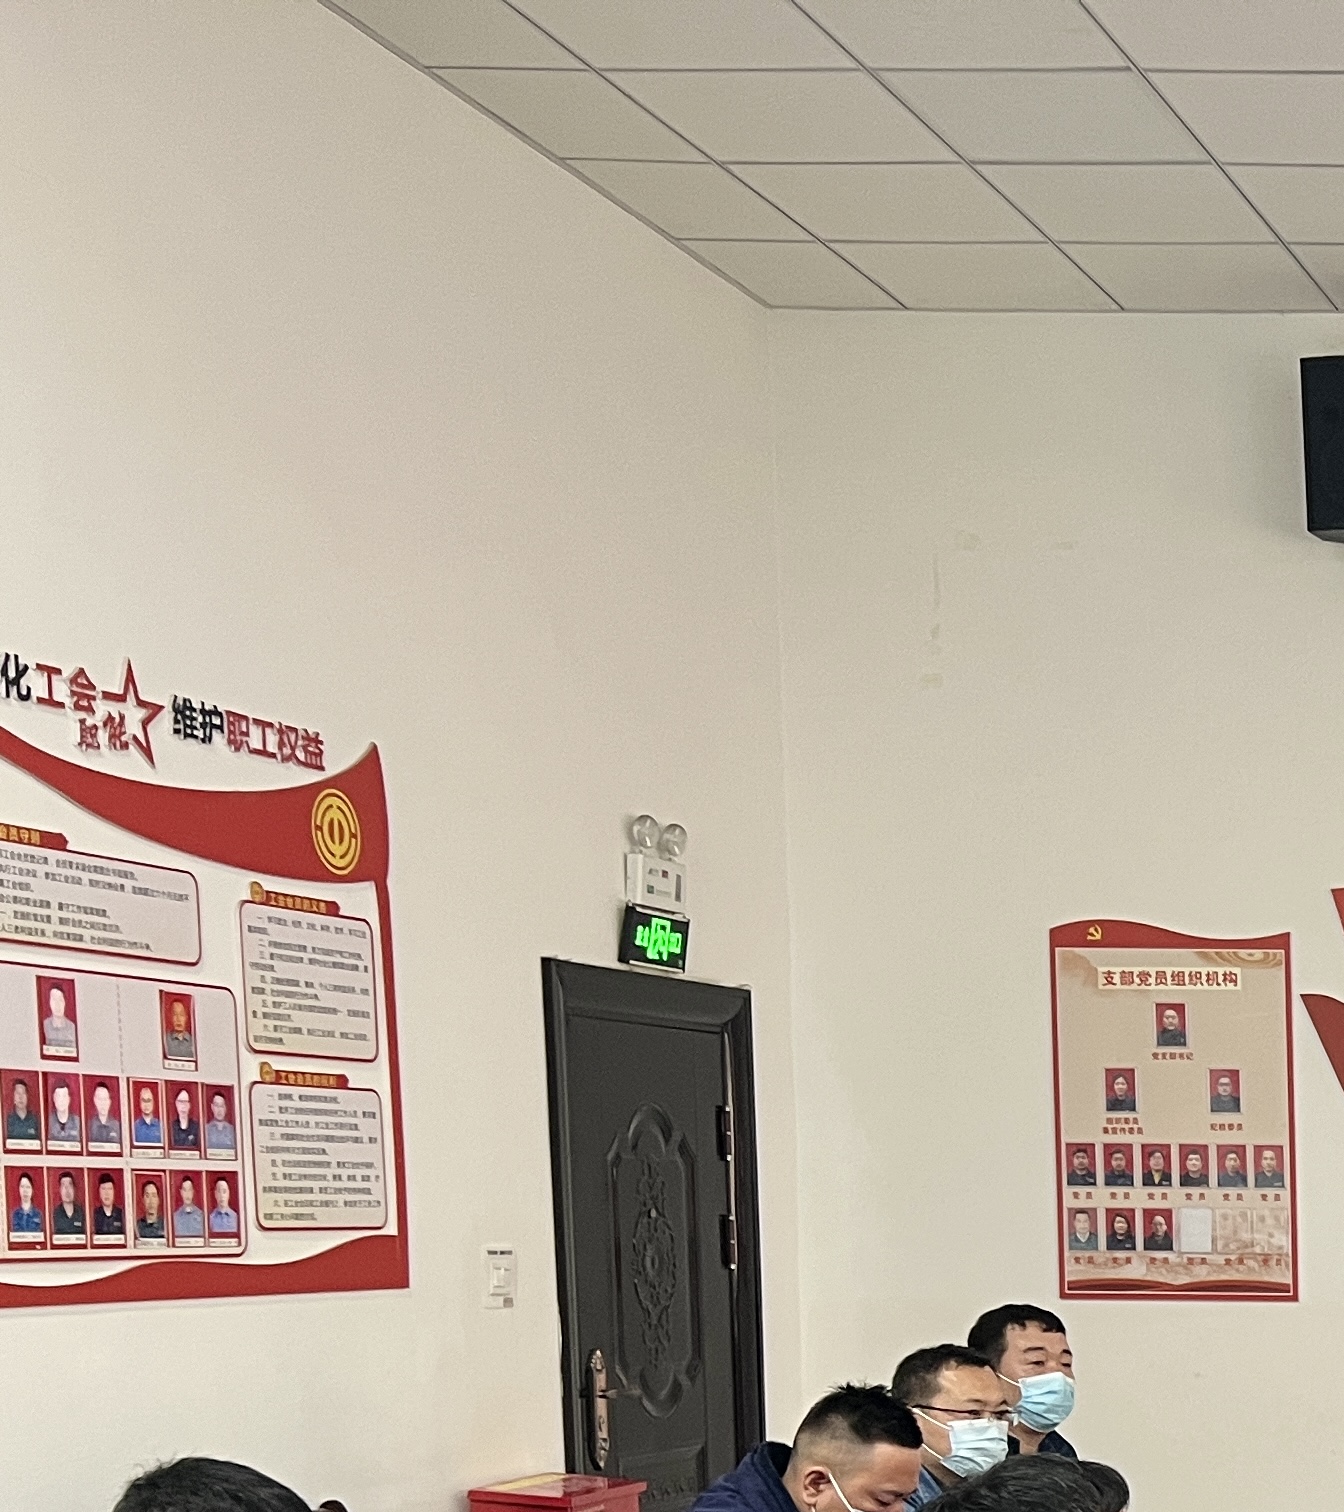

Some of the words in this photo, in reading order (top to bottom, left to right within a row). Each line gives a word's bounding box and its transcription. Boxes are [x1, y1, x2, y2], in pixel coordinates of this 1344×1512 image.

[172, 694, 326, 772] 维护职工权益
[1101, 970, 1239, 988] 支部党员组织机构
